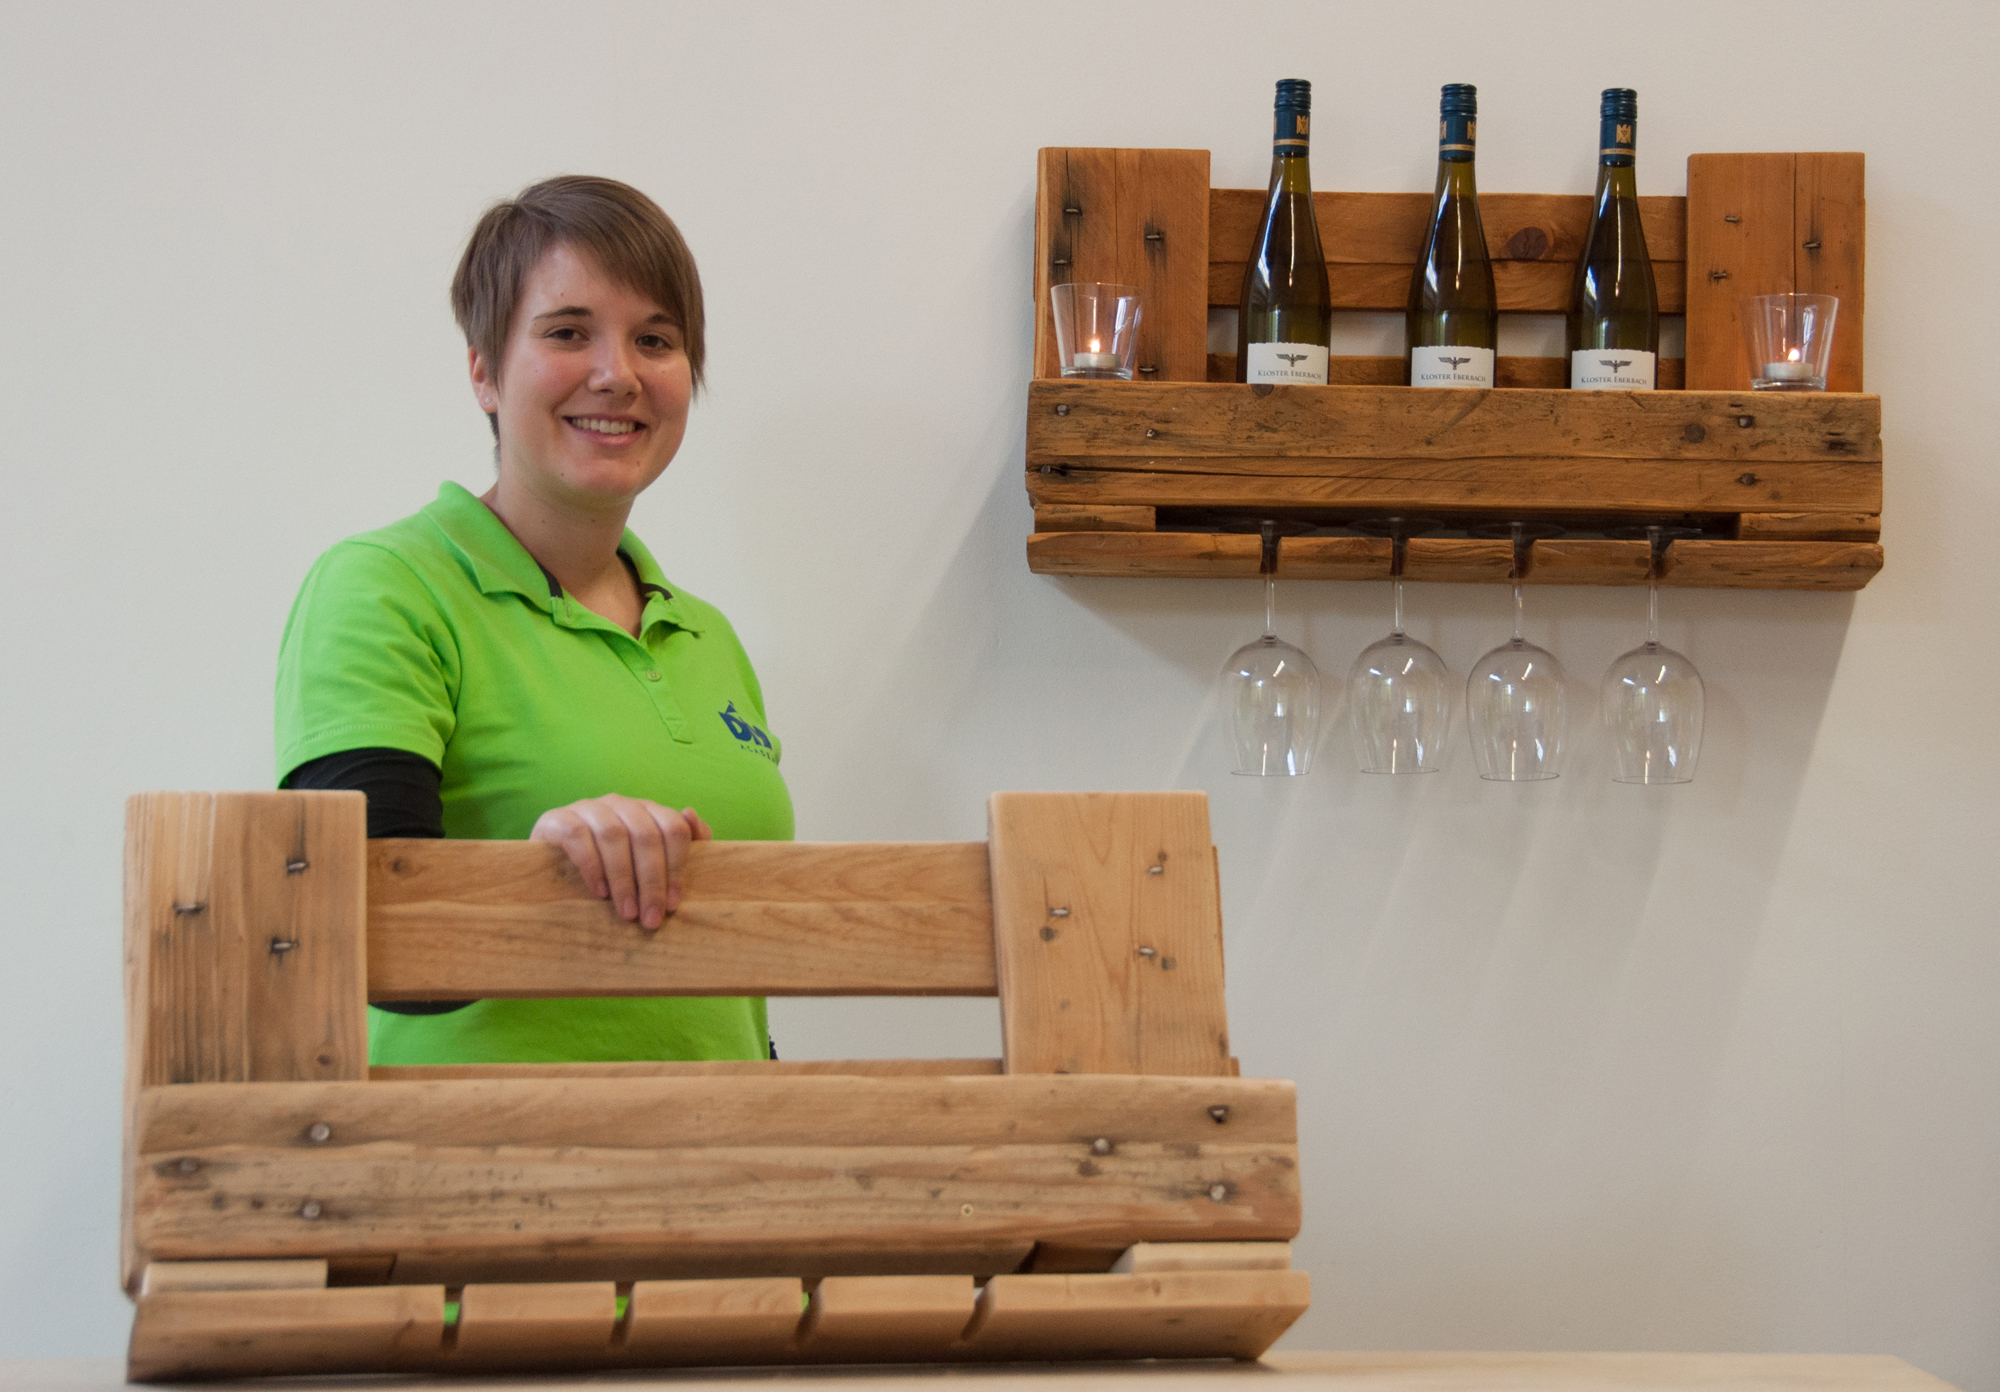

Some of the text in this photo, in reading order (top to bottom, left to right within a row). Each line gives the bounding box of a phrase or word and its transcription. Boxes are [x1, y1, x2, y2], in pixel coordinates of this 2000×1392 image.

[1257, 369, 1322, 380] KLOSTER EBERBACH
[1452, 373, 1486, 382] EBERBACH
[1581, 376, 1647, 385] KLOSTER EBERBACH
